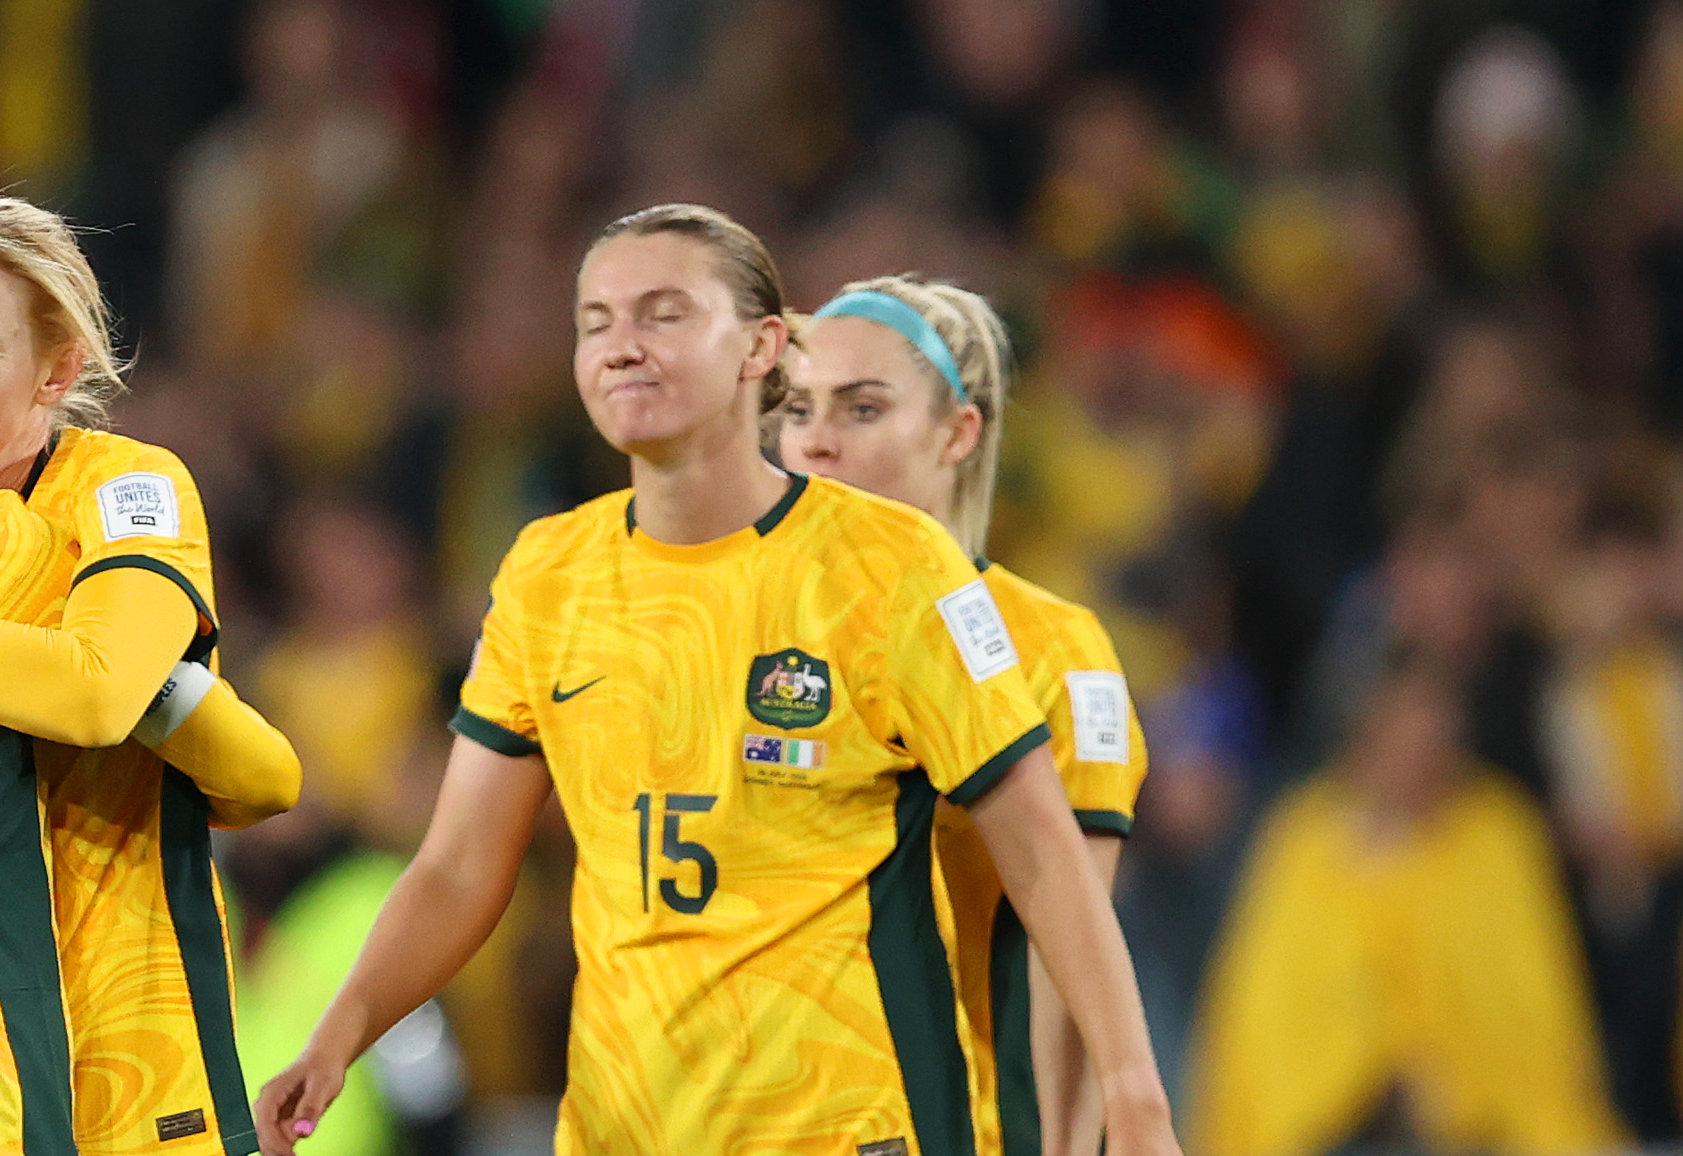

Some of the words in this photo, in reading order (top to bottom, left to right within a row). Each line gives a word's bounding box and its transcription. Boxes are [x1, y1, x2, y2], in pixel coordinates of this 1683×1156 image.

[113, 482, 159, 494] FOOTBALL
[115, 491, 162, 504] UNITES
[132, 516, 156, 525] FIFA
[633, 791, 720, 915] 15
